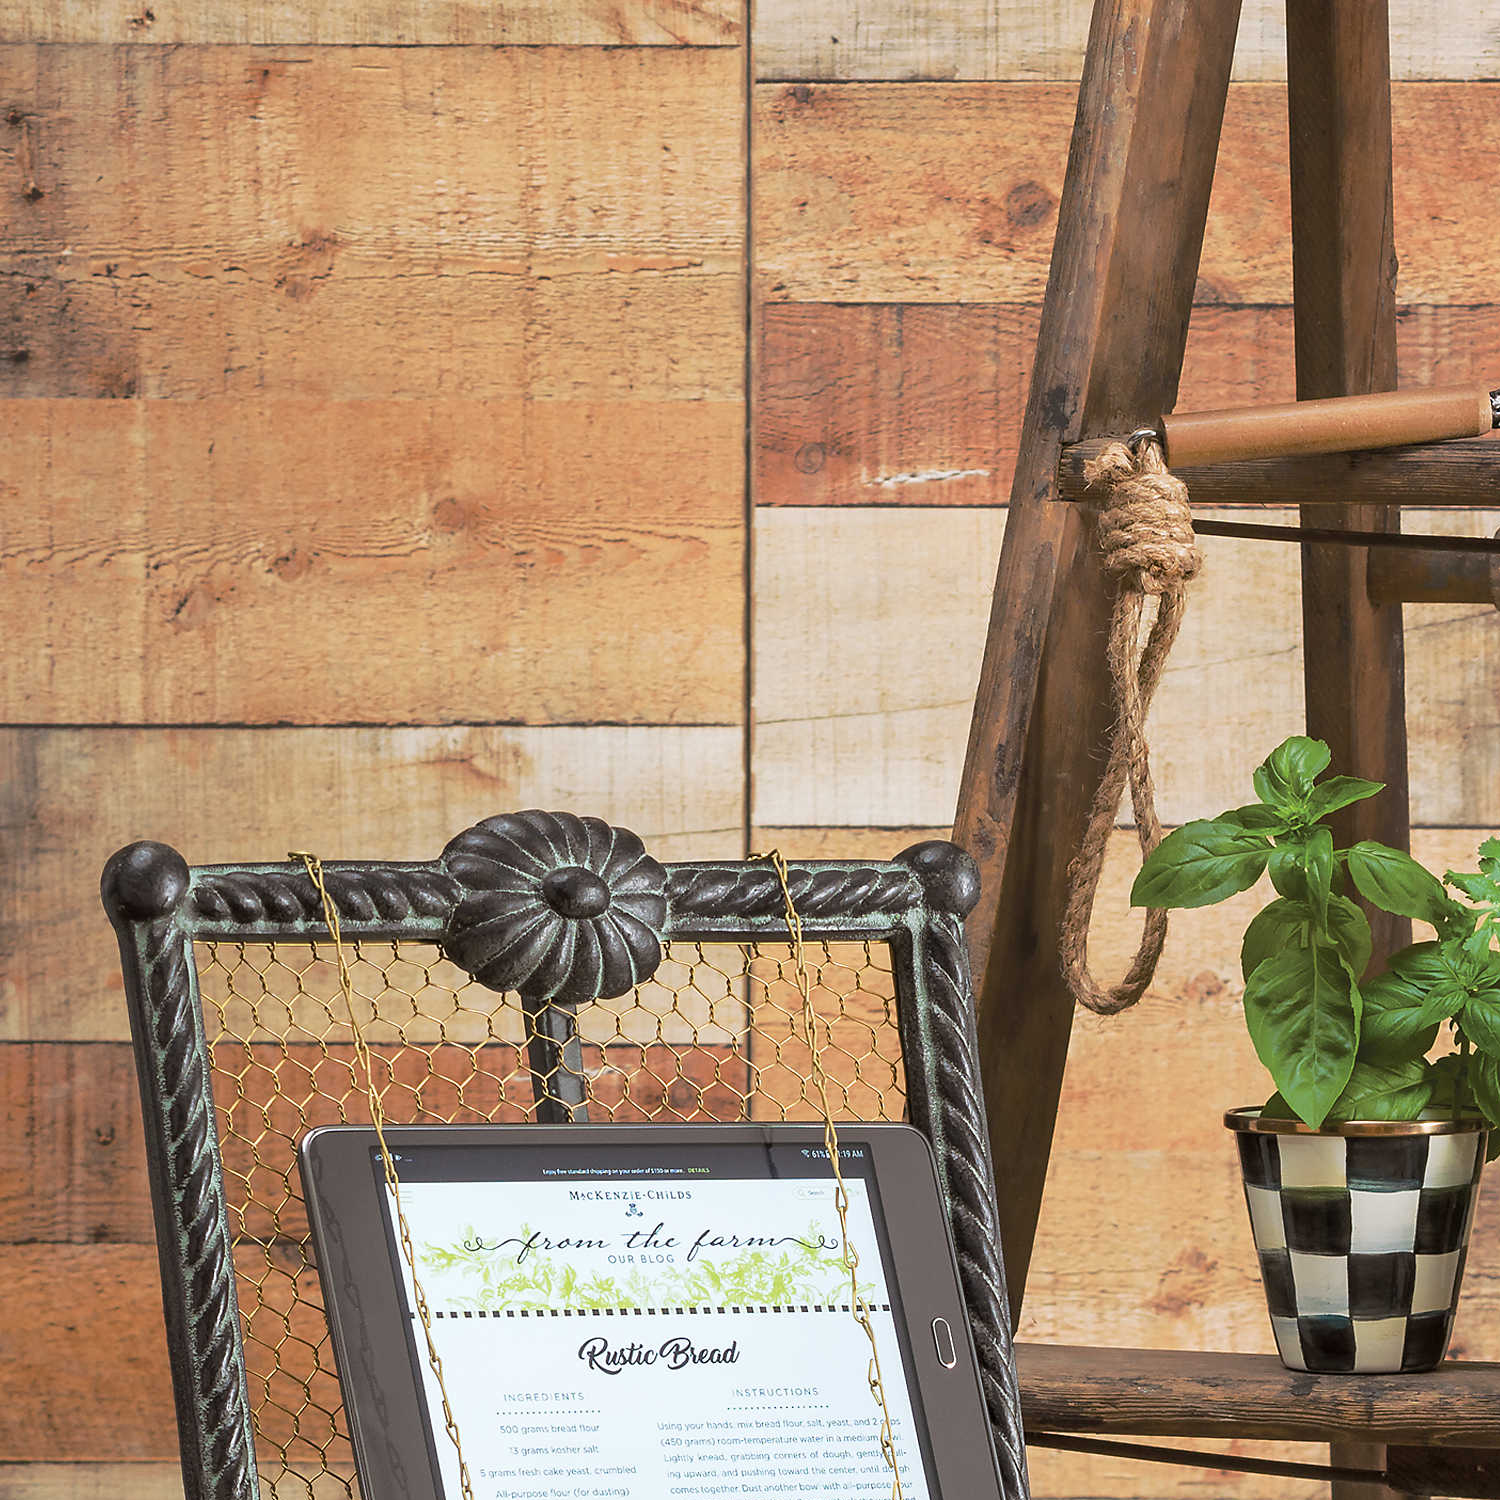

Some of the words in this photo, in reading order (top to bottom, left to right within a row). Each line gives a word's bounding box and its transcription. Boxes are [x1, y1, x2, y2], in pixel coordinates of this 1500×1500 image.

[621, 1222, 680, 1248] the
[608, 1255, 634, 1264] OUR
[641, 1255, 674, 1263] BLOG
[578, 1337, 658, 1375] Rustic
[659, 1337, 740, 1370] Bread
[504, 1392, 585, 1402] INGREDIENTS
[732, 1388, 818, 1396] INSTRUCTIONS
[499, 1426, 519, 1434] 500
[521, 1427, 549, 1435] grams
[550, 1425, 576, 1433] bread
[521, 1448, 549, 1456] grams
[583, 1445, 599, 1453] salt
[489, 1470, 516, 1478] grams
[543, 1467, 564, 1476] cake
[594, 1466, 637, 1474] crumbled
